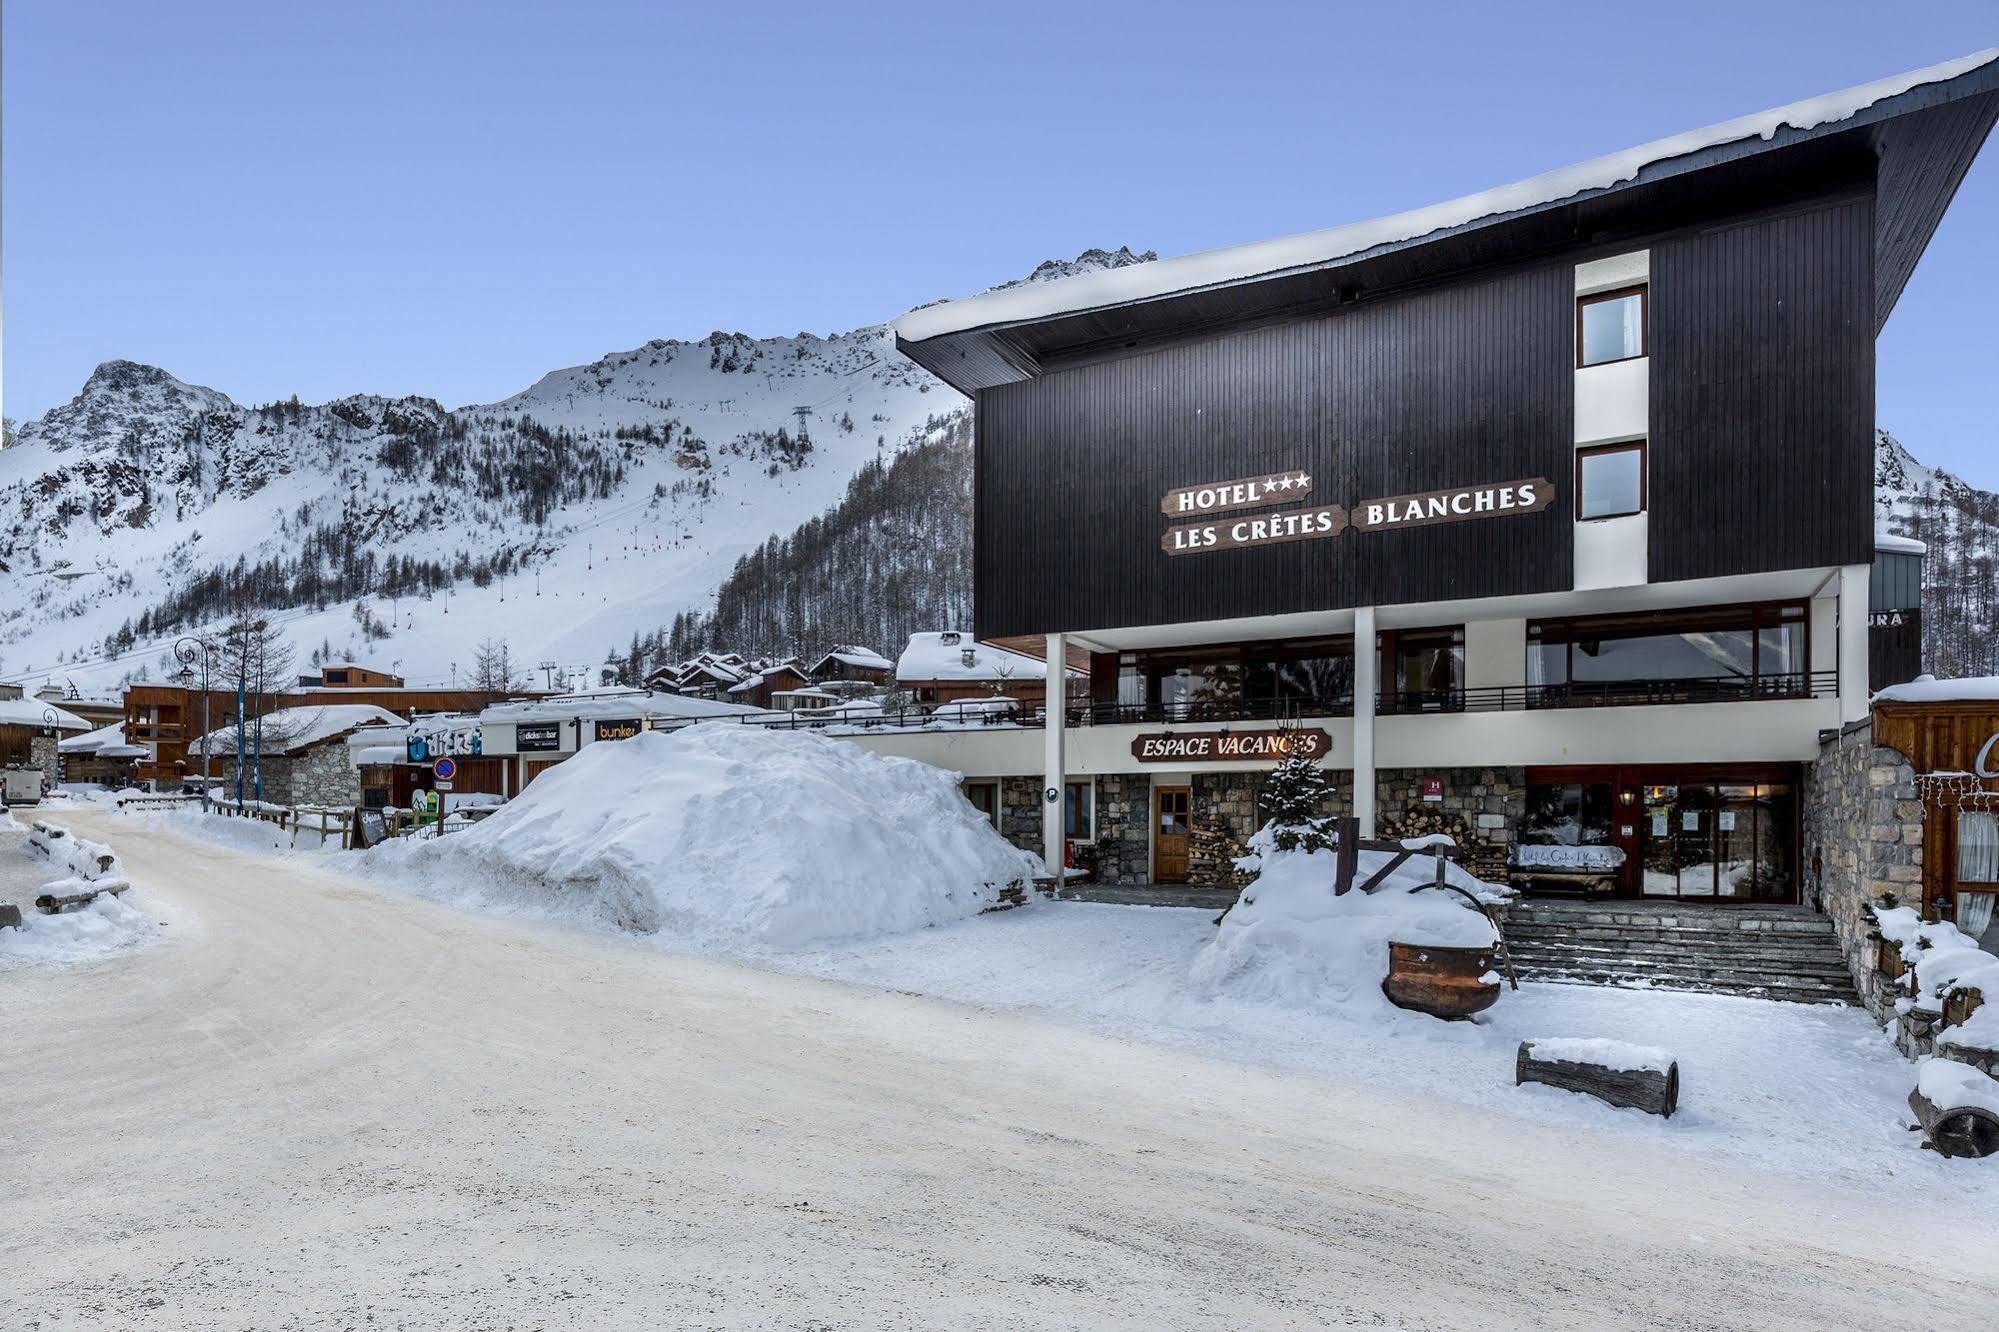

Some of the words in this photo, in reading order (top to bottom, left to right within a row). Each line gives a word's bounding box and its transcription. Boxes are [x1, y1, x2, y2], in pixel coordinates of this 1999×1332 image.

[1178, 482, 1260, 512] HOTEL
[1174, 527, 1217, 550] LES
[1231, 512, 1333, 543] CRÊTES
[1367, 484, 1537, 526] BLANCHES
[600, 724, 636, 739] bunker
[1142, 737, 1211, 757] ESPACE
[1431, 781, 1440, 789] H
